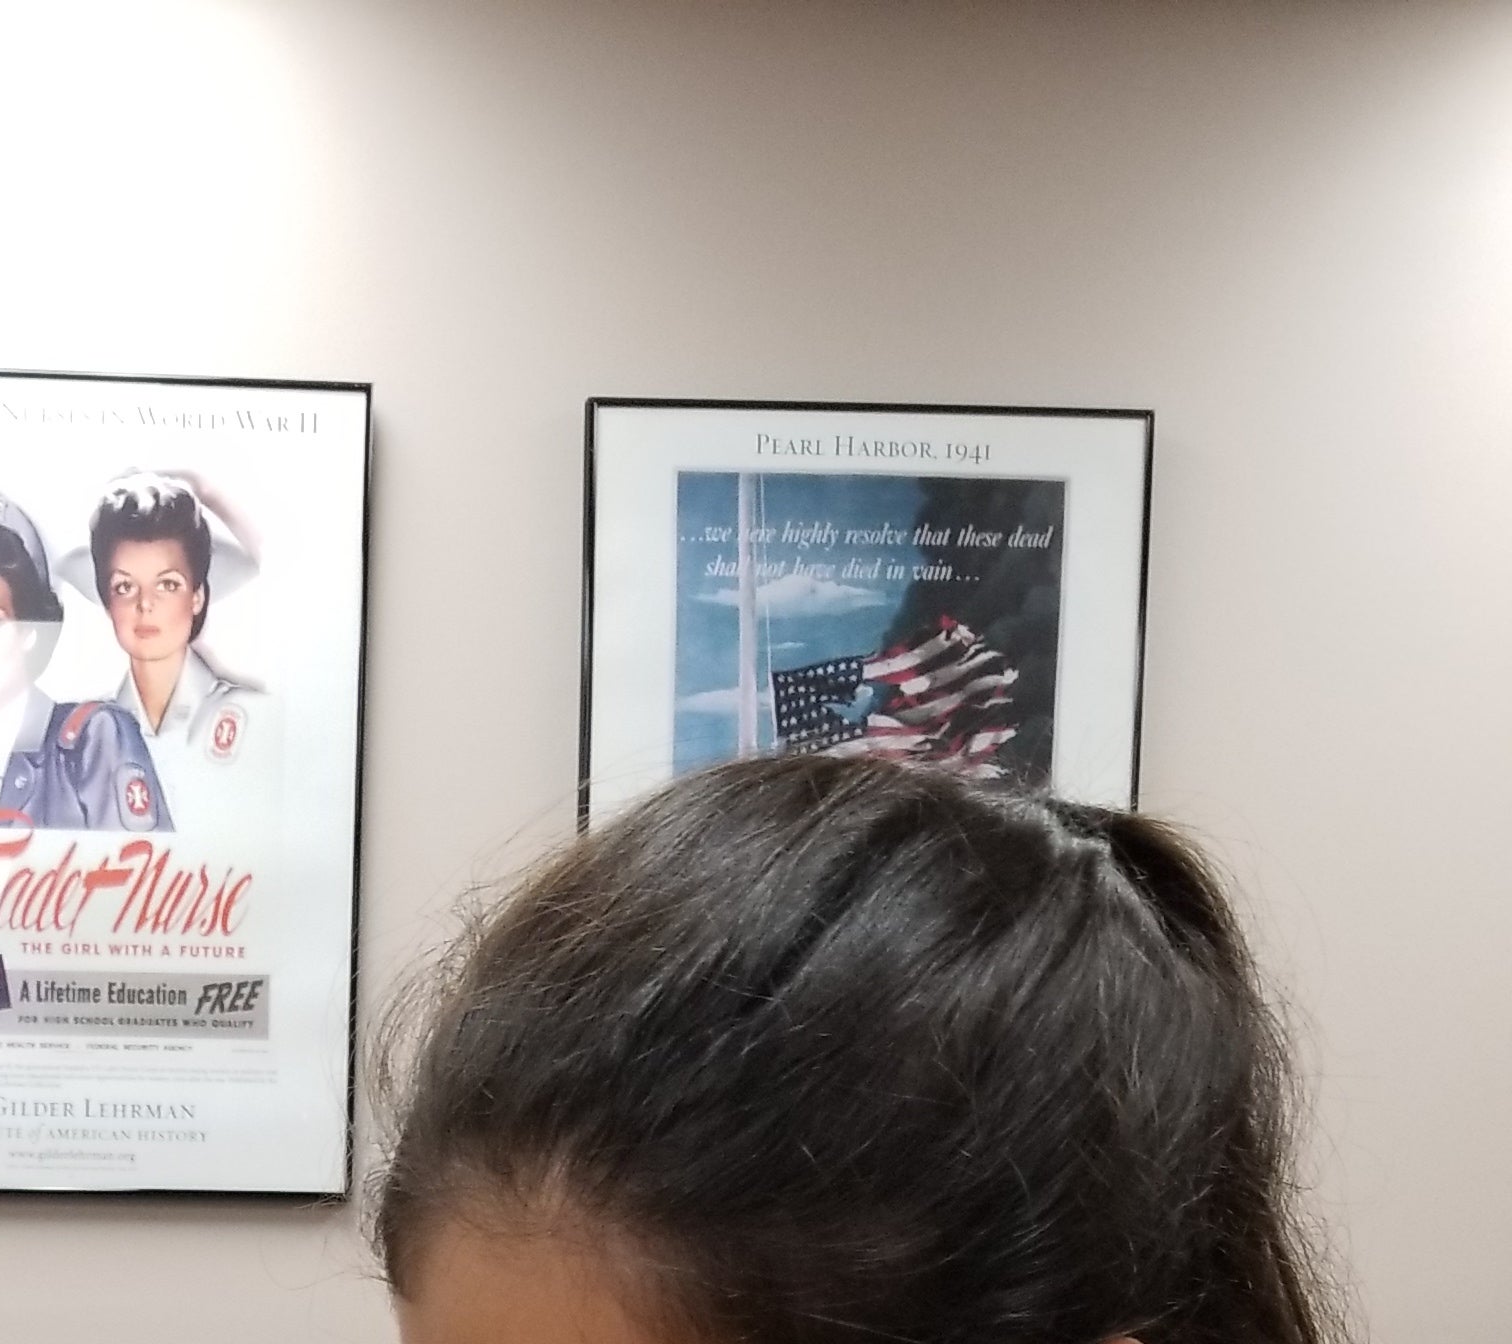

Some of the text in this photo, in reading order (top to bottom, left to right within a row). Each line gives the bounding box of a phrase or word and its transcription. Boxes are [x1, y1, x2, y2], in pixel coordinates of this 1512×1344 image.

[755, 433, 992, 465] PEARL HARBOR, 1941
[781, 520, 839, 551] highly
[843, 522, 908, 546] resolve
[912, 523, 952, 547] that
[956, 523, 1004, 548] these
[1007, 524, 1055, 549] dead
[792, 556, 836, 579] have
[841, 557, 882, 580] died
[886, 558, 906, 581] in
[20, 941, 247, 959] THE GIRL WITH A FUTURE
[19, 979, 31, 1004] A
[35, 980, 102, 1005] Lifetime
[107, 981, 188, 1006] Education
[194, 979, 264, 1016] FREE
[84, 1098, 197, 1120] LEHRMAN
[47, 1126, 132, 1142] AMERICAN
[138, 1129, 209, 1144] HISTORY
